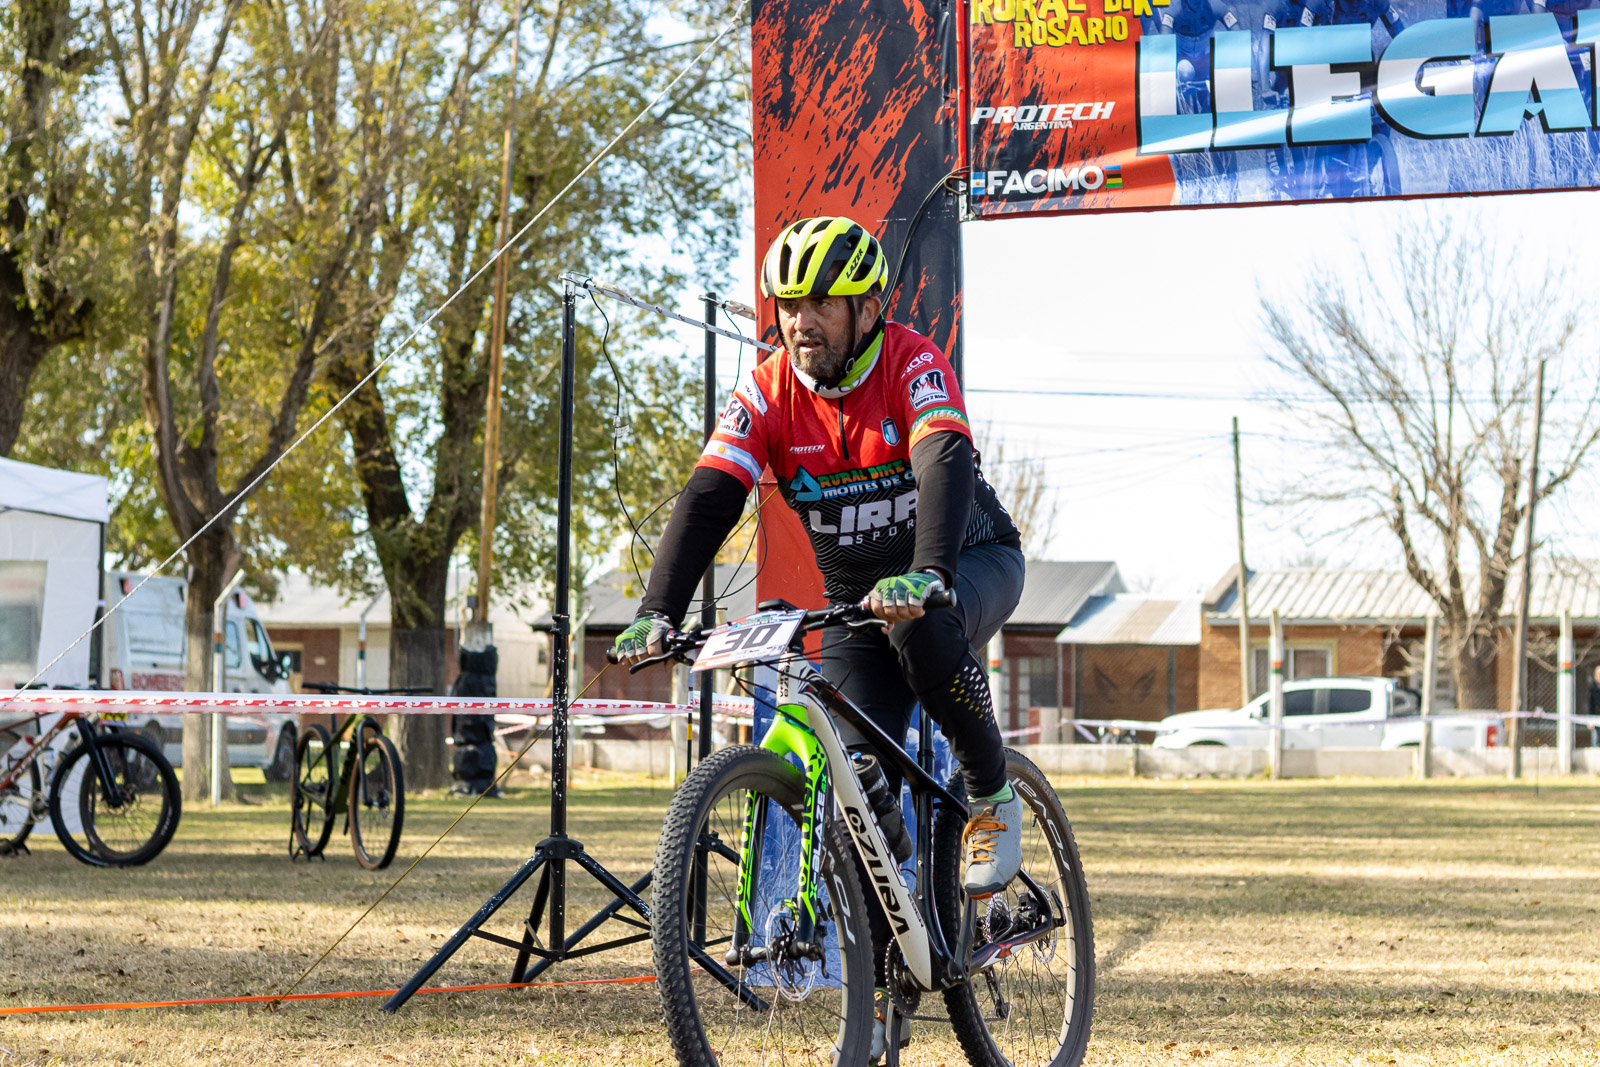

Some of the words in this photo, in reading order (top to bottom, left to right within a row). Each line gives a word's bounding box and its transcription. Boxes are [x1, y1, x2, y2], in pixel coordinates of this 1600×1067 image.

[1014, 15, 1128, 47] ROSARIO
[970, 101, 1116, 125] PROTECH
[1011, 120, 1074, 131] ARGENTINA
[987, 165, 1104, 195] FACIMO
[845, 248, 864, 279] LAZER
[817, 469, 867, 488] RURAL
[868, 460, 905, 479] BIKE
[880, 475, 902, 489] DE
[904, 470, 915, 481] O
[855, 519, 915, 544] SPOR
[712, 622, 782, 656] 30
